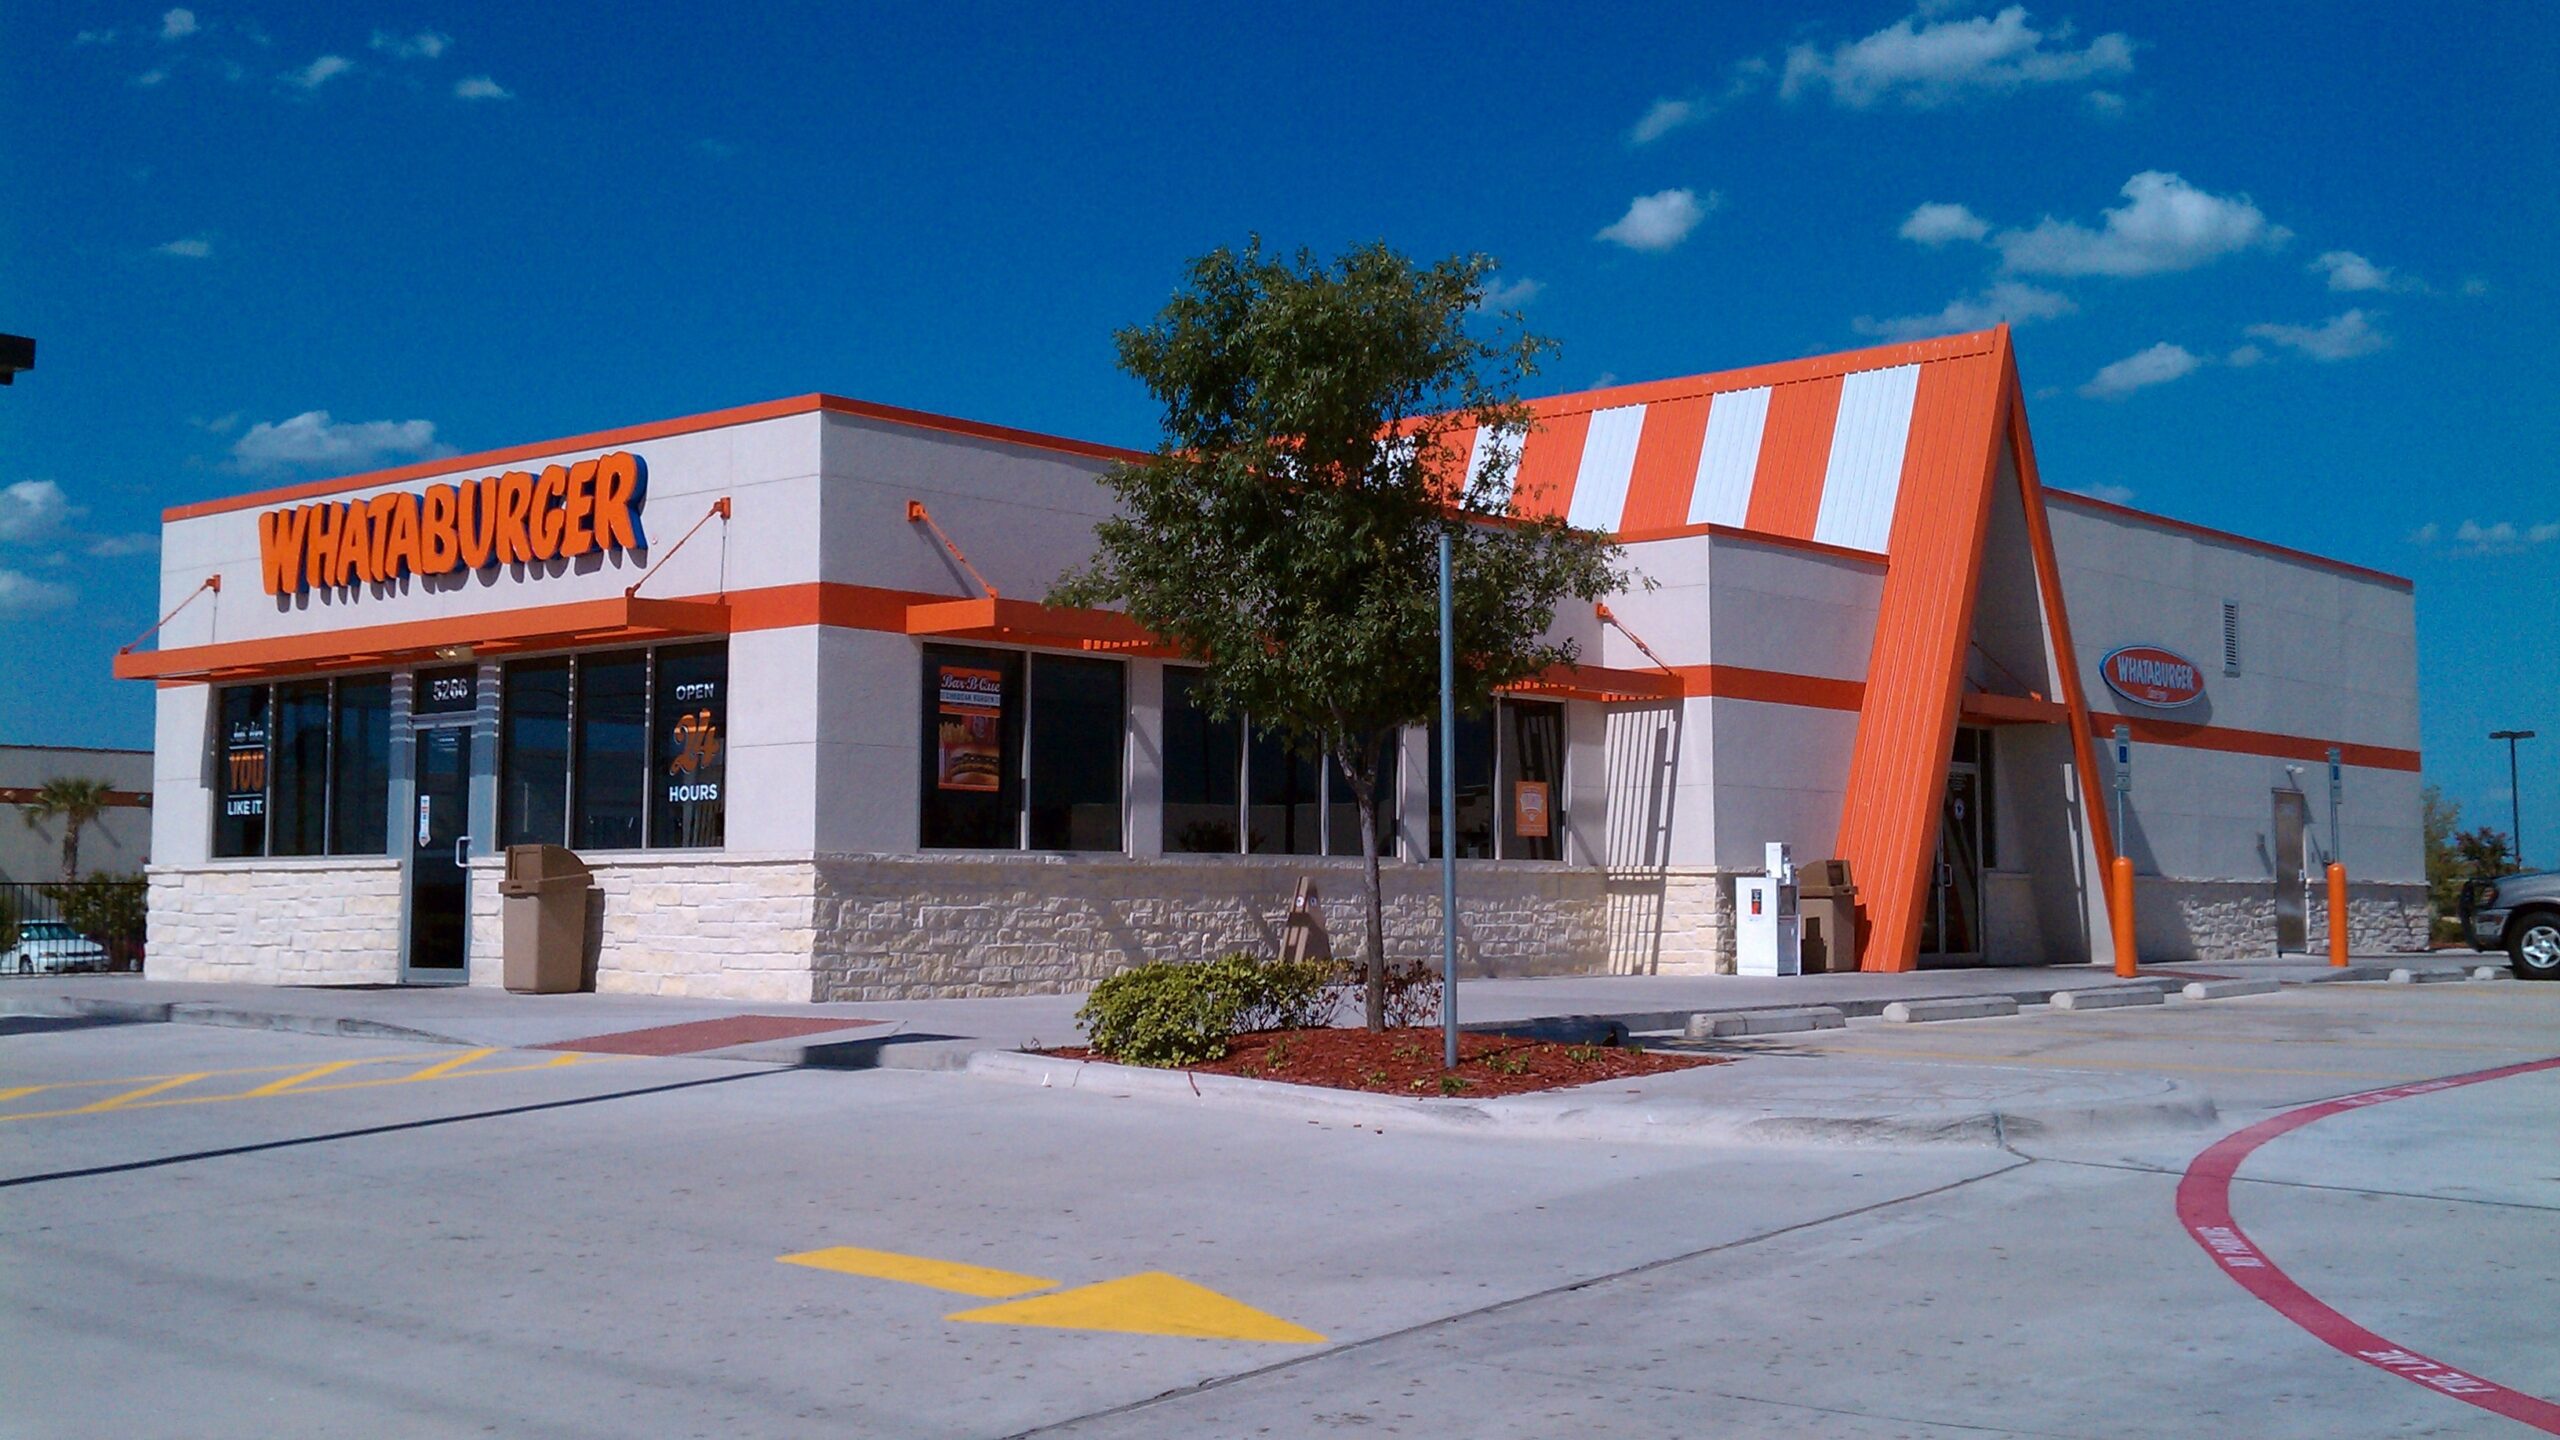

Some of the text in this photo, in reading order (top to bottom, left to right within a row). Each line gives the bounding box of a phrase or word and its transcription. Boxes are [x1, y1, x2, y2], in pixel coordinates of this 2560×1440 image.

[258, 451, 647, 595] WHATABURGER
[2116, 655, 2194, 691] WHATABURGER
[433, 678, 468, 700] 5266
[675, 683, 714, 700] OPEN
[669, 708, 720, 776] 24
[229, 751, 265, 791] YOU
[669, 783, 718, 802] HOURS
[227, 800, 251, 816] LIKE
[2413, 1372, 2496, 1393] FIRE
